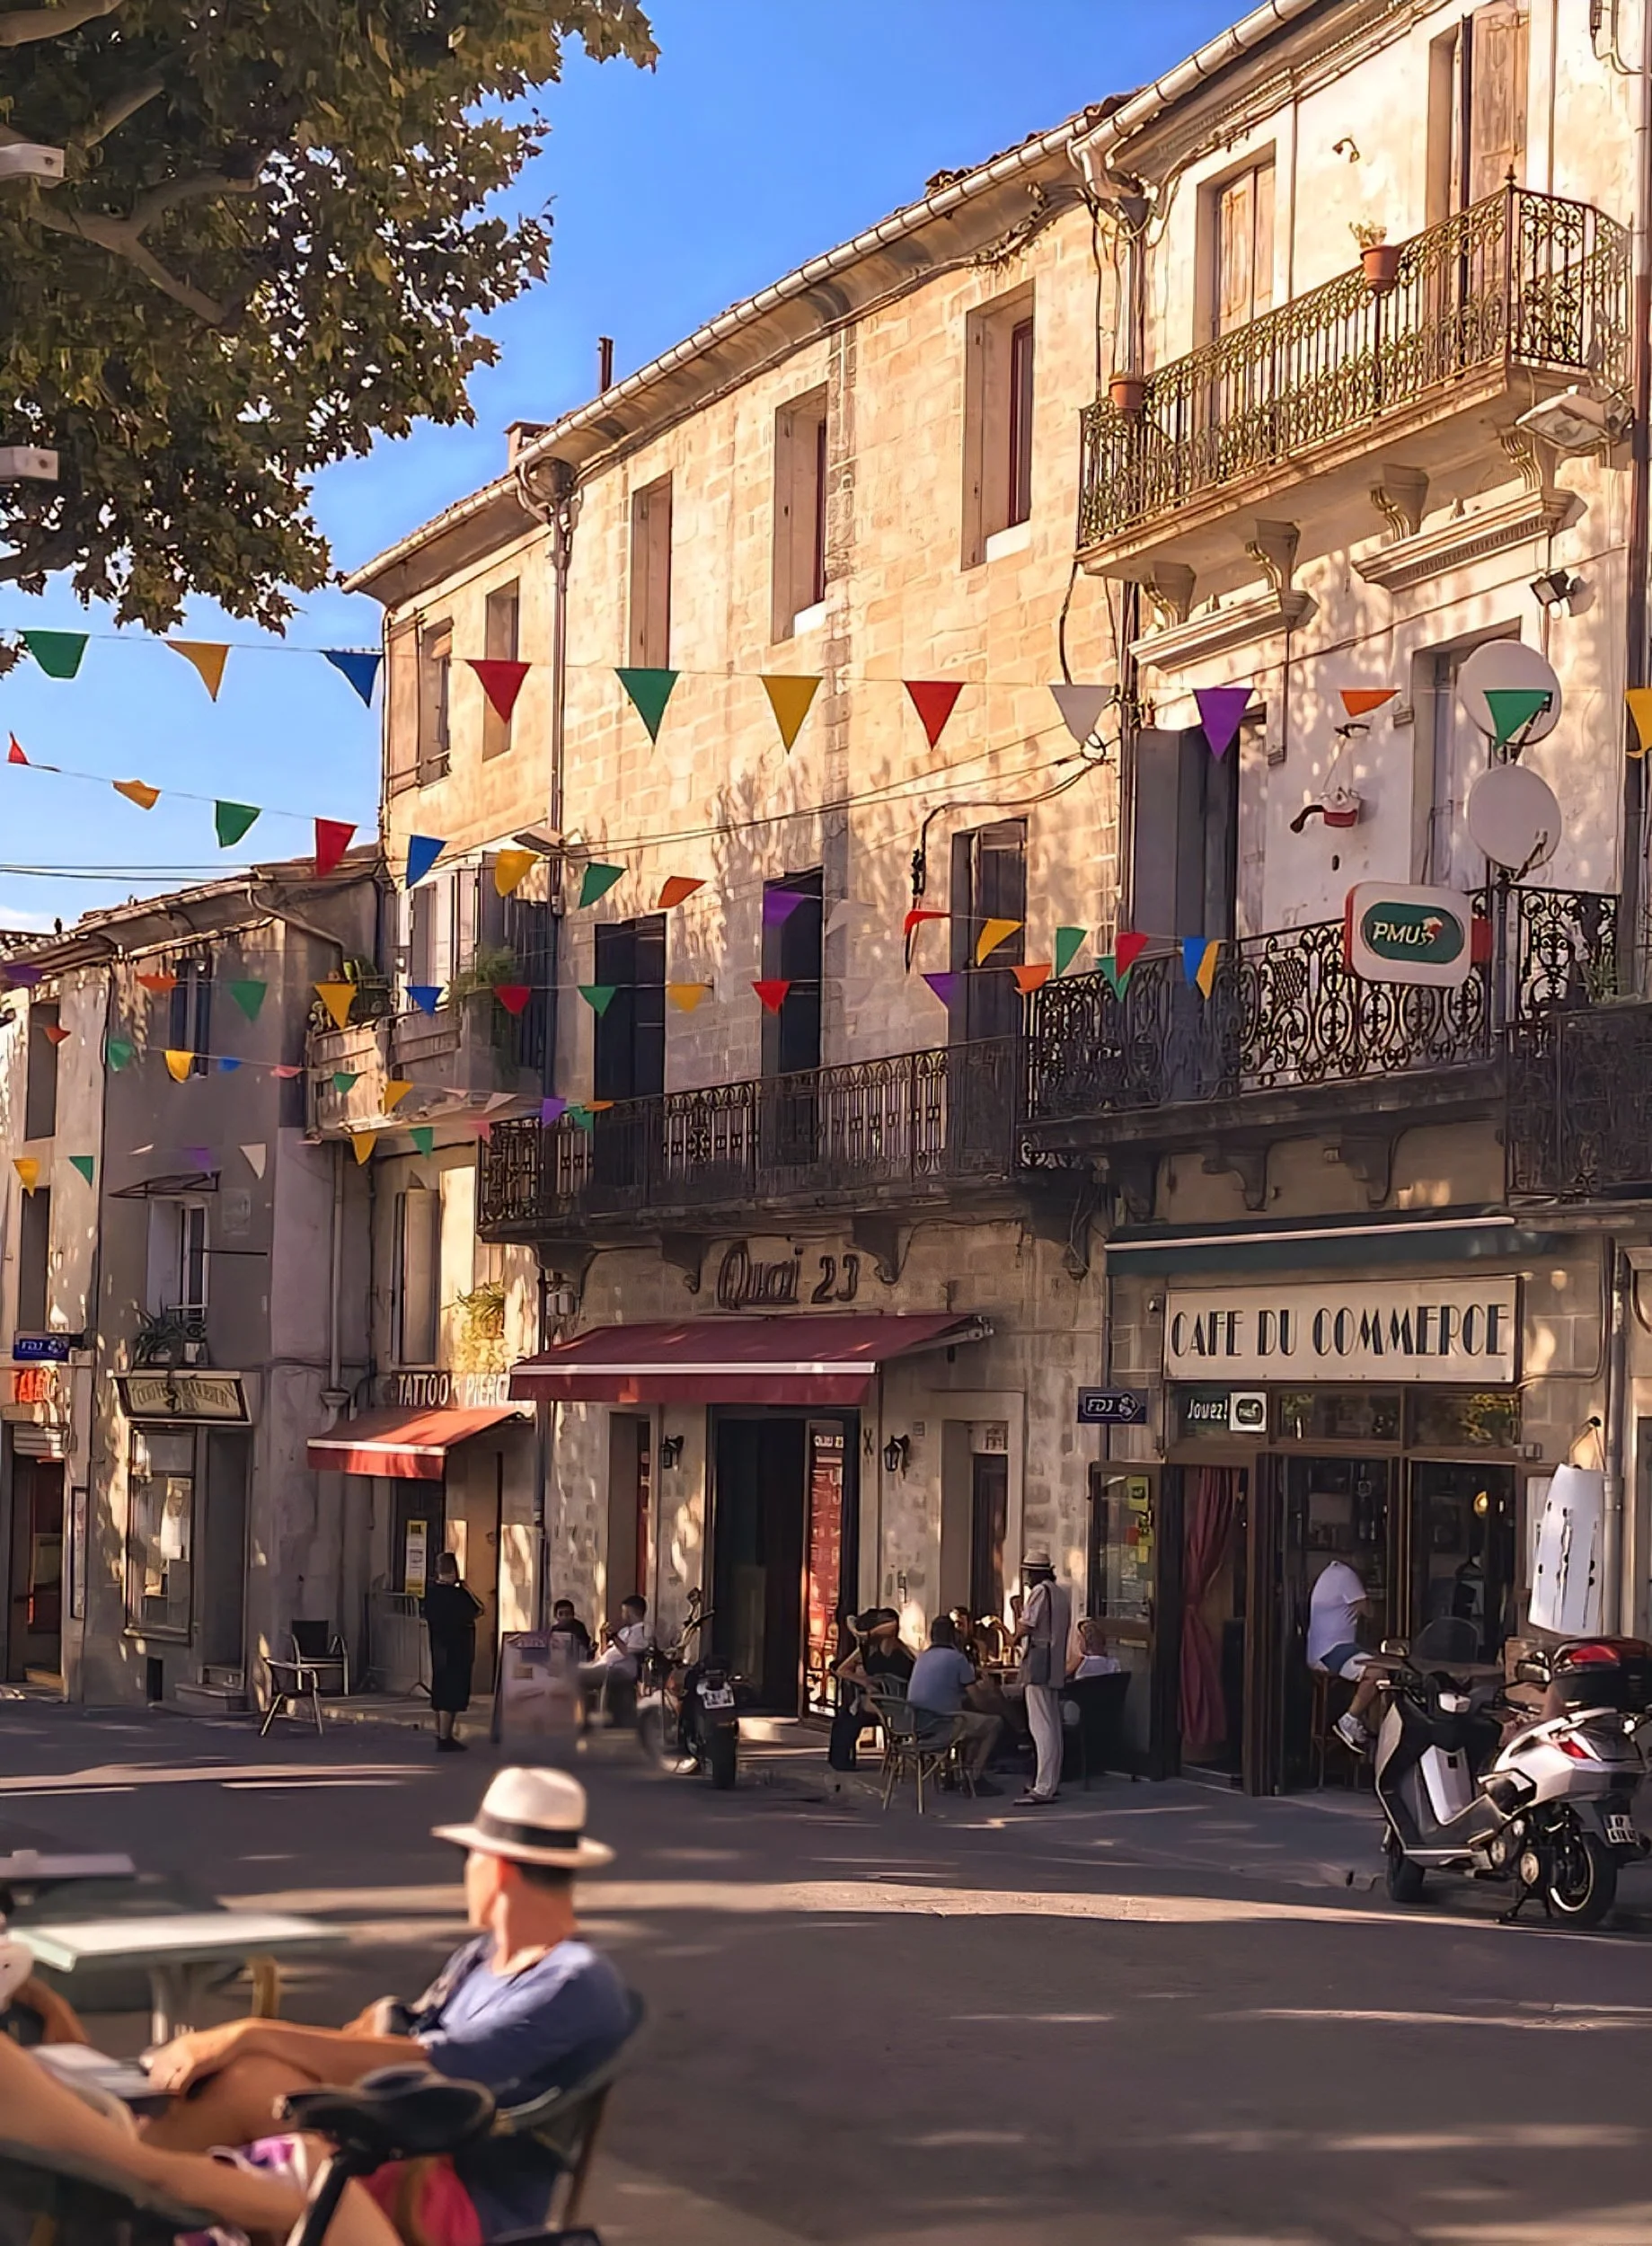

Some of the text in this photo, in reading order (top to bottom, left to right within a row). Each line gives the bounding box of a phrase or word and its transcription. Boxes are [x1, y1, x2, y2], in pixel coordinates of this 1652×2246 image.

[1372, 921, 1421, 945] PMU
[718, 1241, 860, 1311] Quai 23
[1171, 1304, 1510, 1357] CAFE DU COMMERCE
[397, 1373, 449, 1407] TATTOO
[1087, 1398, 1114, 1412] FDJ
[1187, 1398, 1229, 1420] Jouez!
